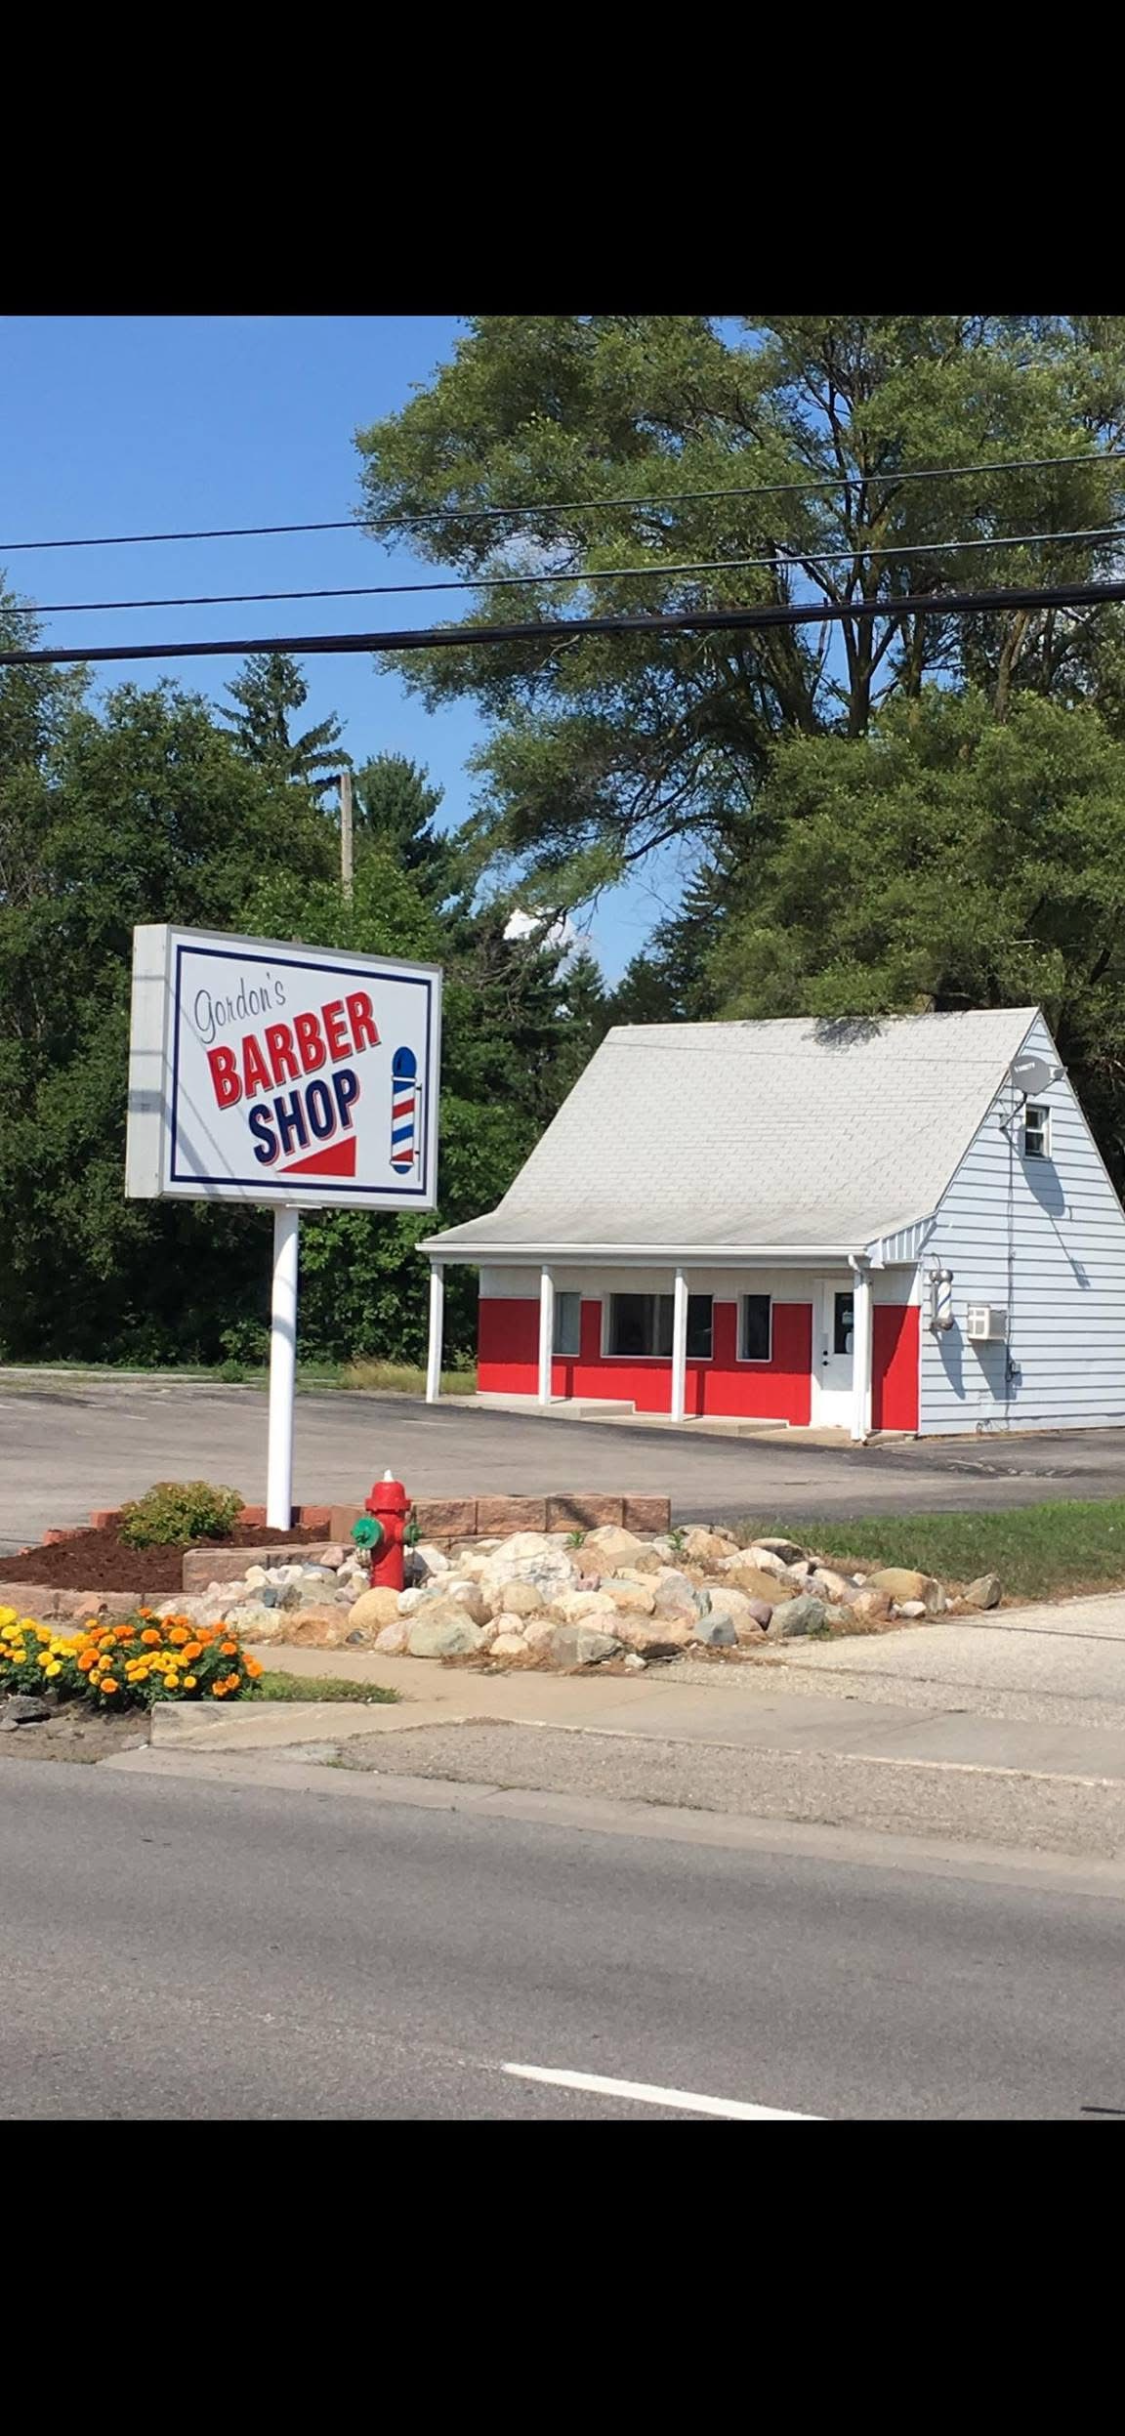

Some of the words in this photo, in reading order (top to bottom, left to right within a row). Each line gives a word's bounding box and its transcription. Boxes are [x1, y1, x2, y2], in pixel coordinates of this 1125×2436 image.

[194, 972, 286, 1044] Gordon's
[207, 991, 381, 1109] BARBER
[249, 1068, 360, 1166] SHOP
